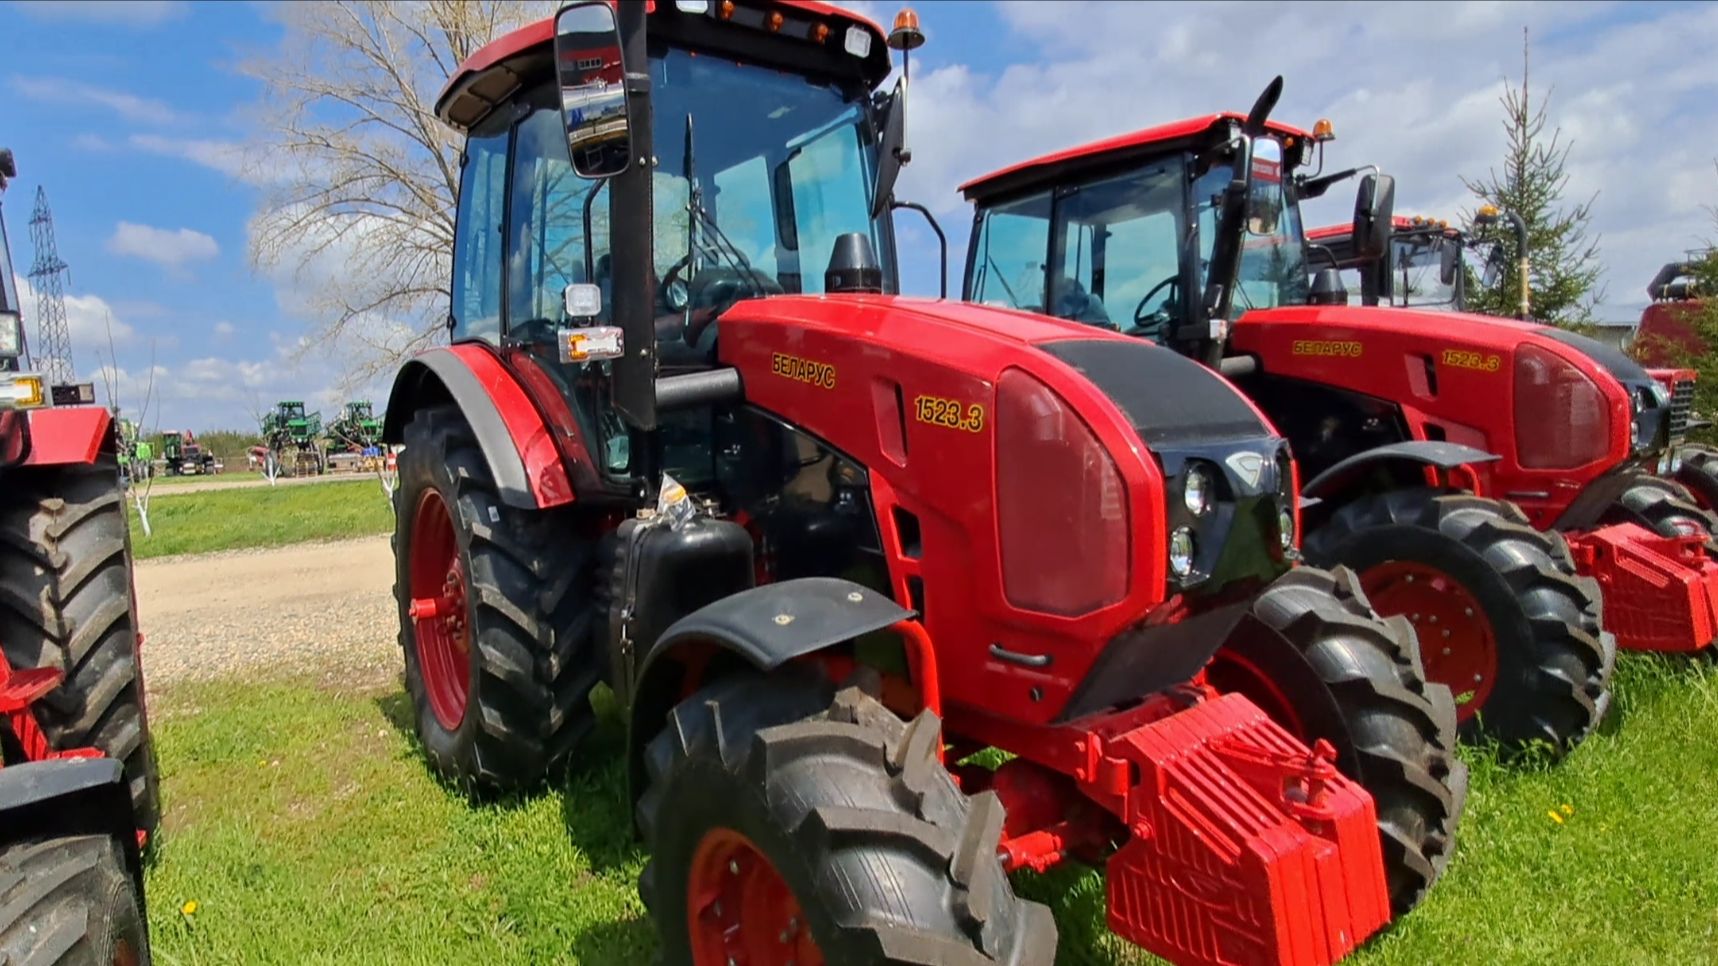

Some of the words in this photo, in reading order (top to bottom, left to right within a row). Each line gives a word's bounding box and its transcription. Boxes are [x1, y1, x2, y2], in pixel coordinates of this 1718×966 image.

[1293, 341, 1362, 357] БЕЛАРУС
[1441, 350, 1500, 371] 1523.3
[772, 352, 835, 388] БЕЛАРУС
[915, 395, 983, 432] 1523.3
